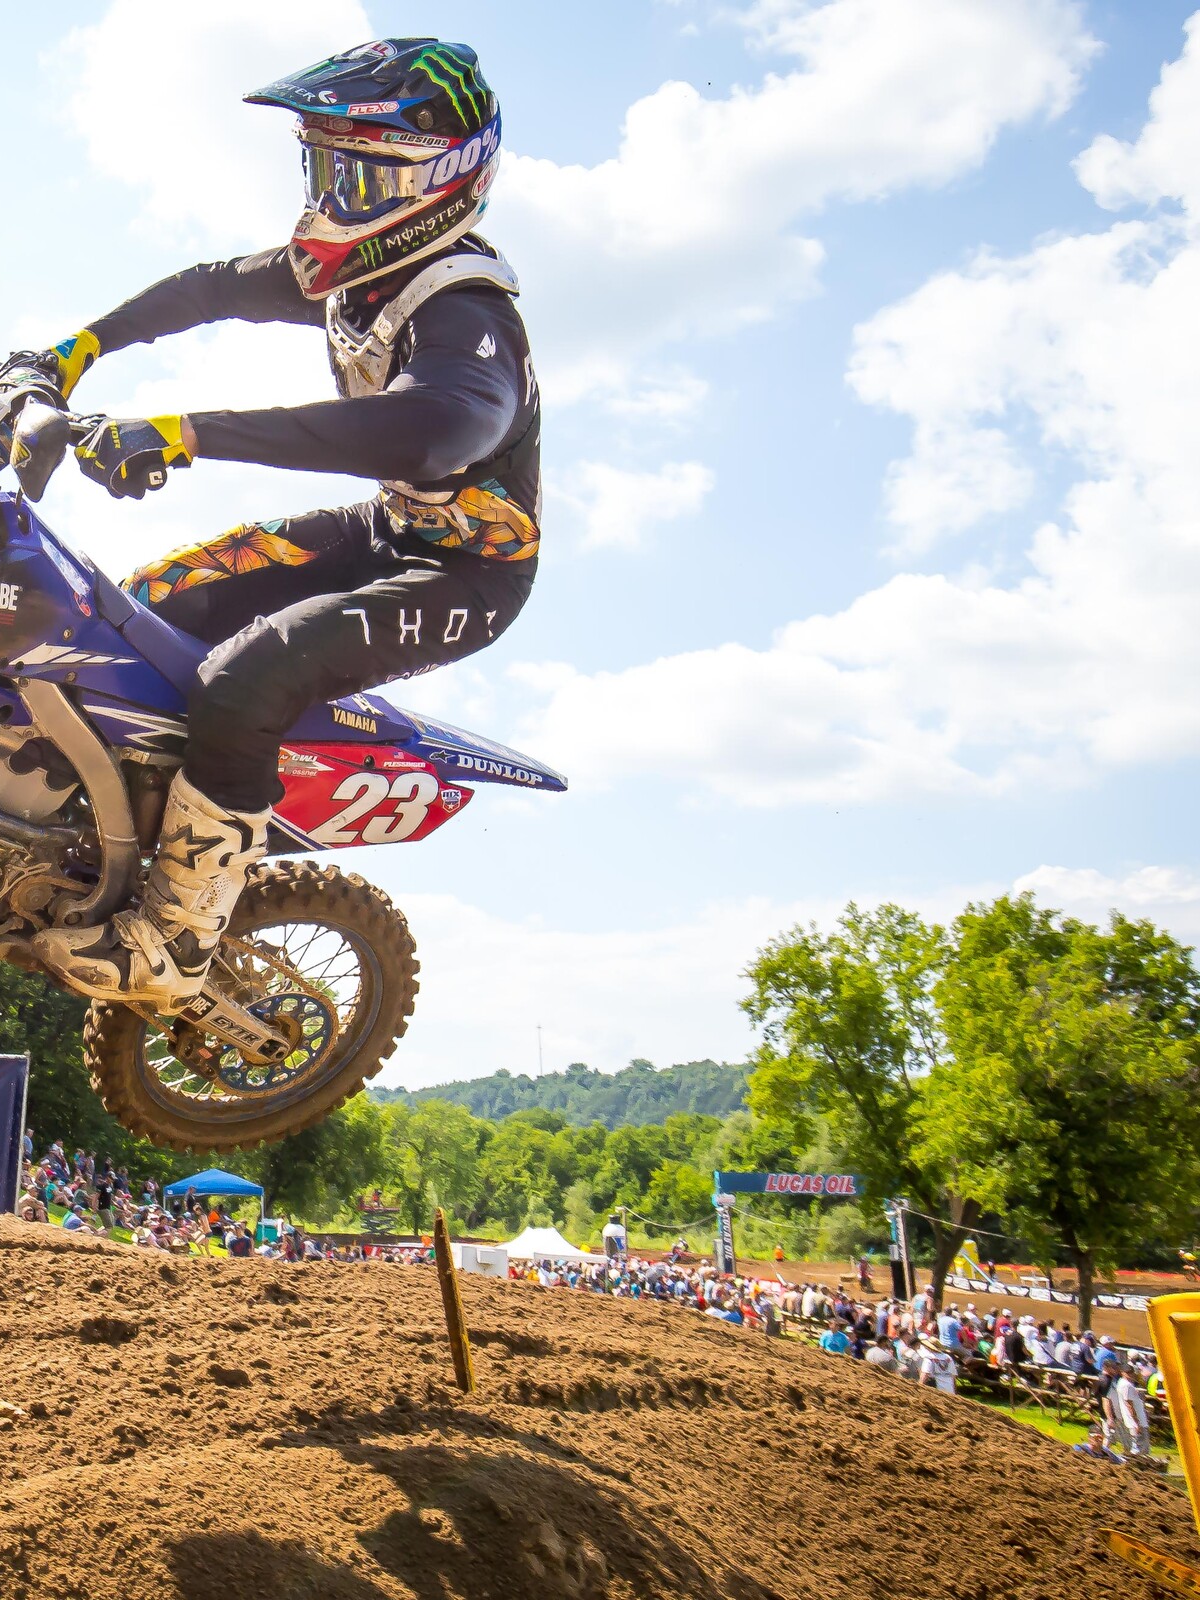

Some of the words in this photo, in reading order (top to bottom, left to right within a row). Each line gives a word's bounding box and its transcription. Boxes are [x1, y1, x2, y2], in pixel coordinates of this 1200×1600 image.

[419, 120, 498, 195] 100%
[333, 708, 377, 734] YAMAHA
[457, 754, 542, 786] DUNLOP
[308, 772, 439, 844] 23
[766, 1174, 824, 1194] LUCAS
[825, 1175, 856, 1195] OIL
